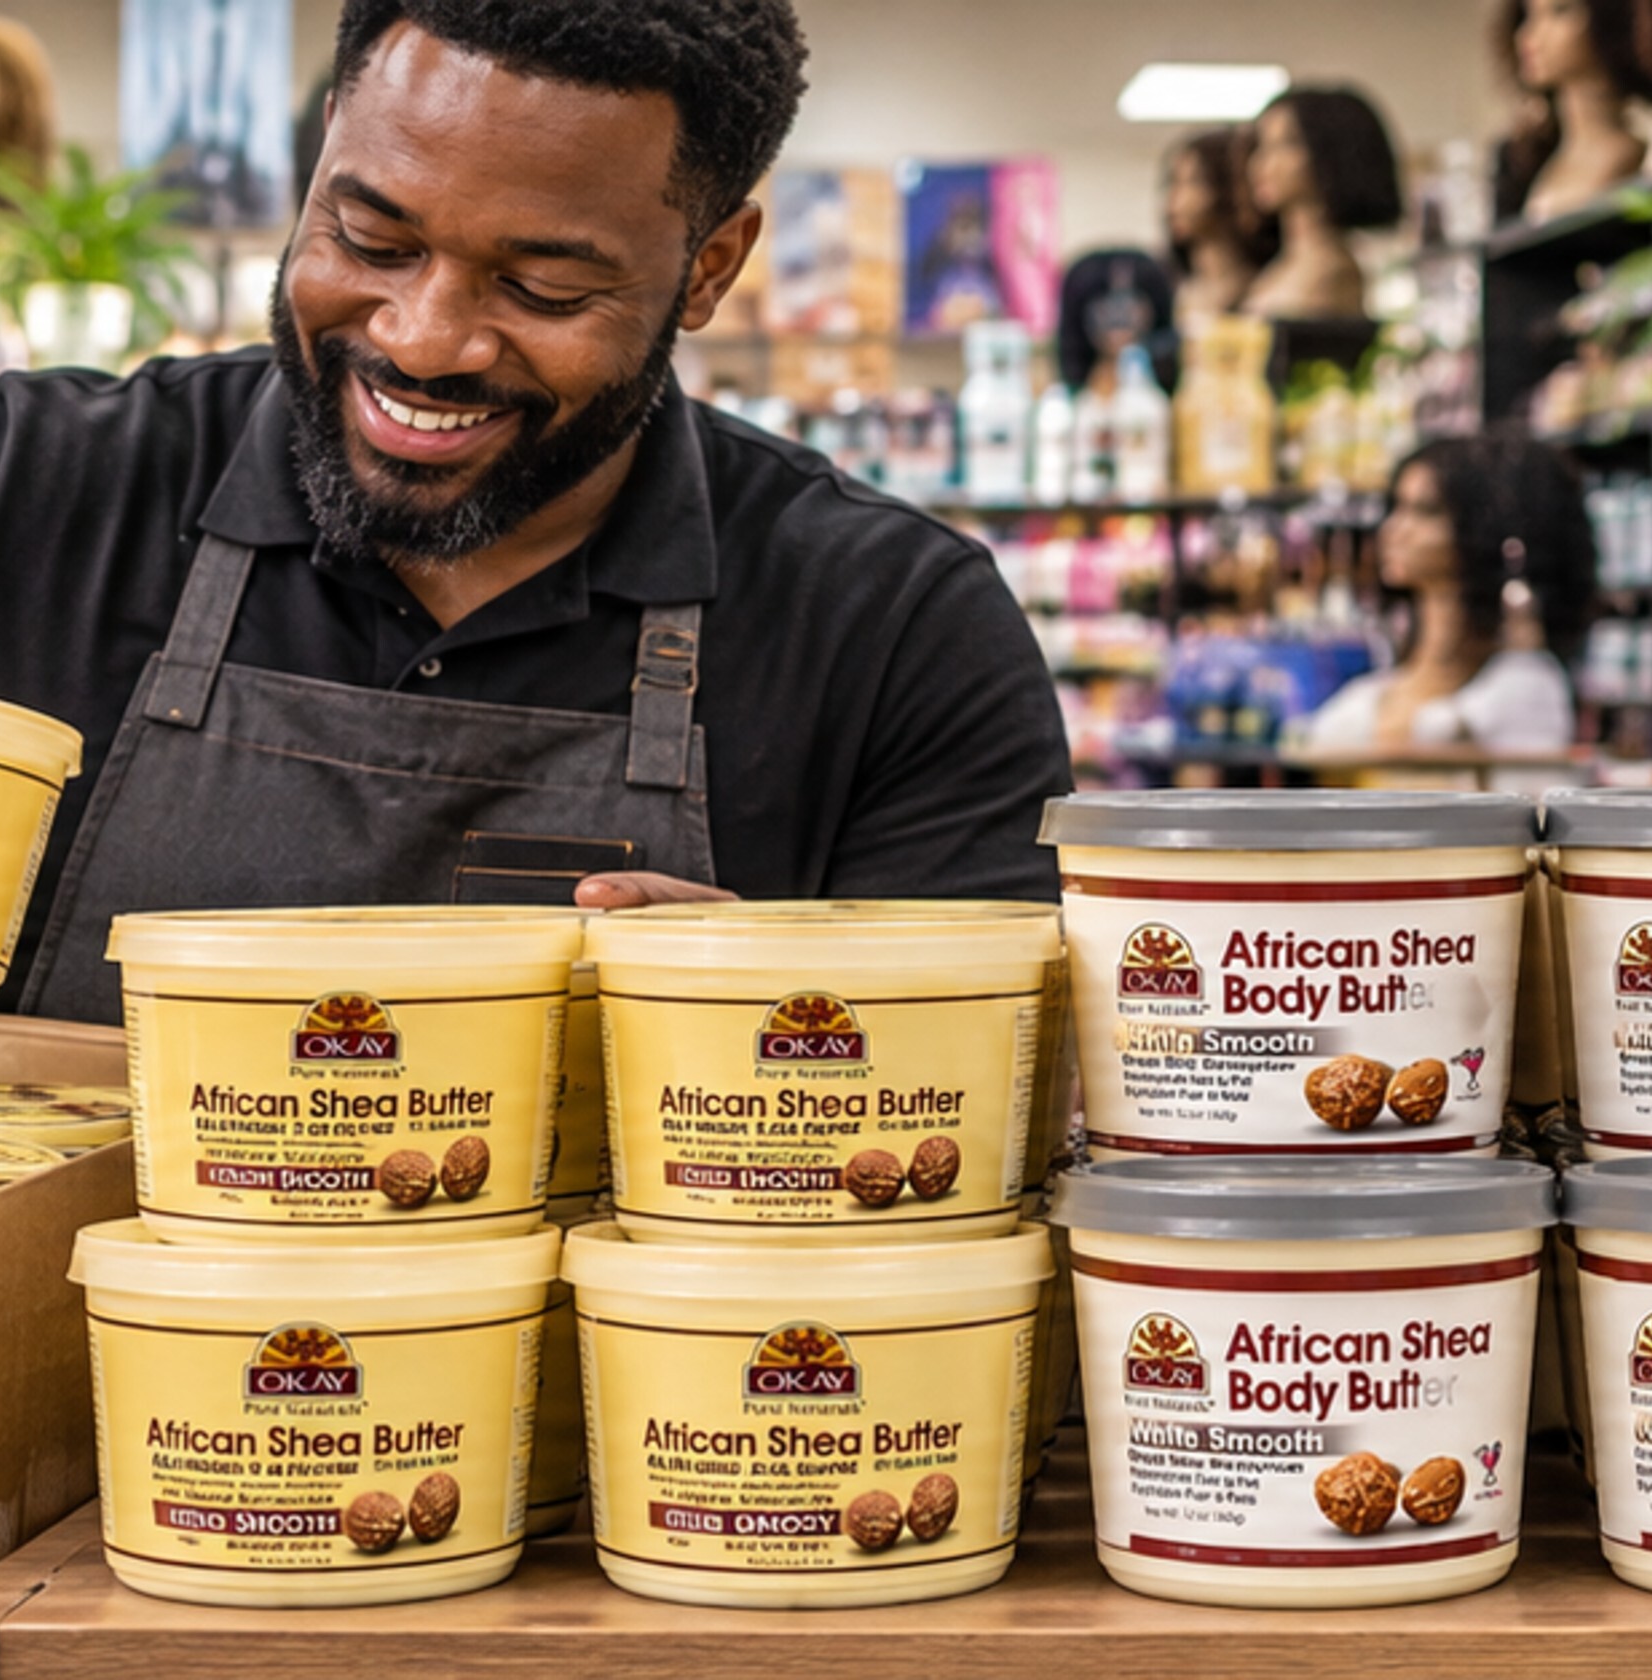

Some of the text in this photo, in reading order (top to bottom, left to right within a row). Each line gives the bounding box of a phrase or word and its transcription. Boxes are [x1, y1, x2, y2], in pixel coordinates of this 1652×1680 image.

[1220, 928, 1476, 968] African Shea
[1222, 975, 1331, 1022] Body
[303, 1035, 389, 1058] OKAY
[766, 1036, 858, 1058] OKAY
[1203, 1030, 1315, 1055] Smooth
[190, 1084, 494, 1118] African Shea Butter
[659, 1085, 965, 1119] African Shea Butter
[1225, 1320, 1491, 1365] African Shea
[257, 1371, 349, 1393] OKAY
[756, 1371, 849, 1394] OKAY
[1228, 1370, 1339, 1422] Body
[147, 1418, 465, 1458] African Shea Butter
[643, 1419, 963, 1457] African Shea Butter
[1208, 1425, 1324, 1454] Smooth
